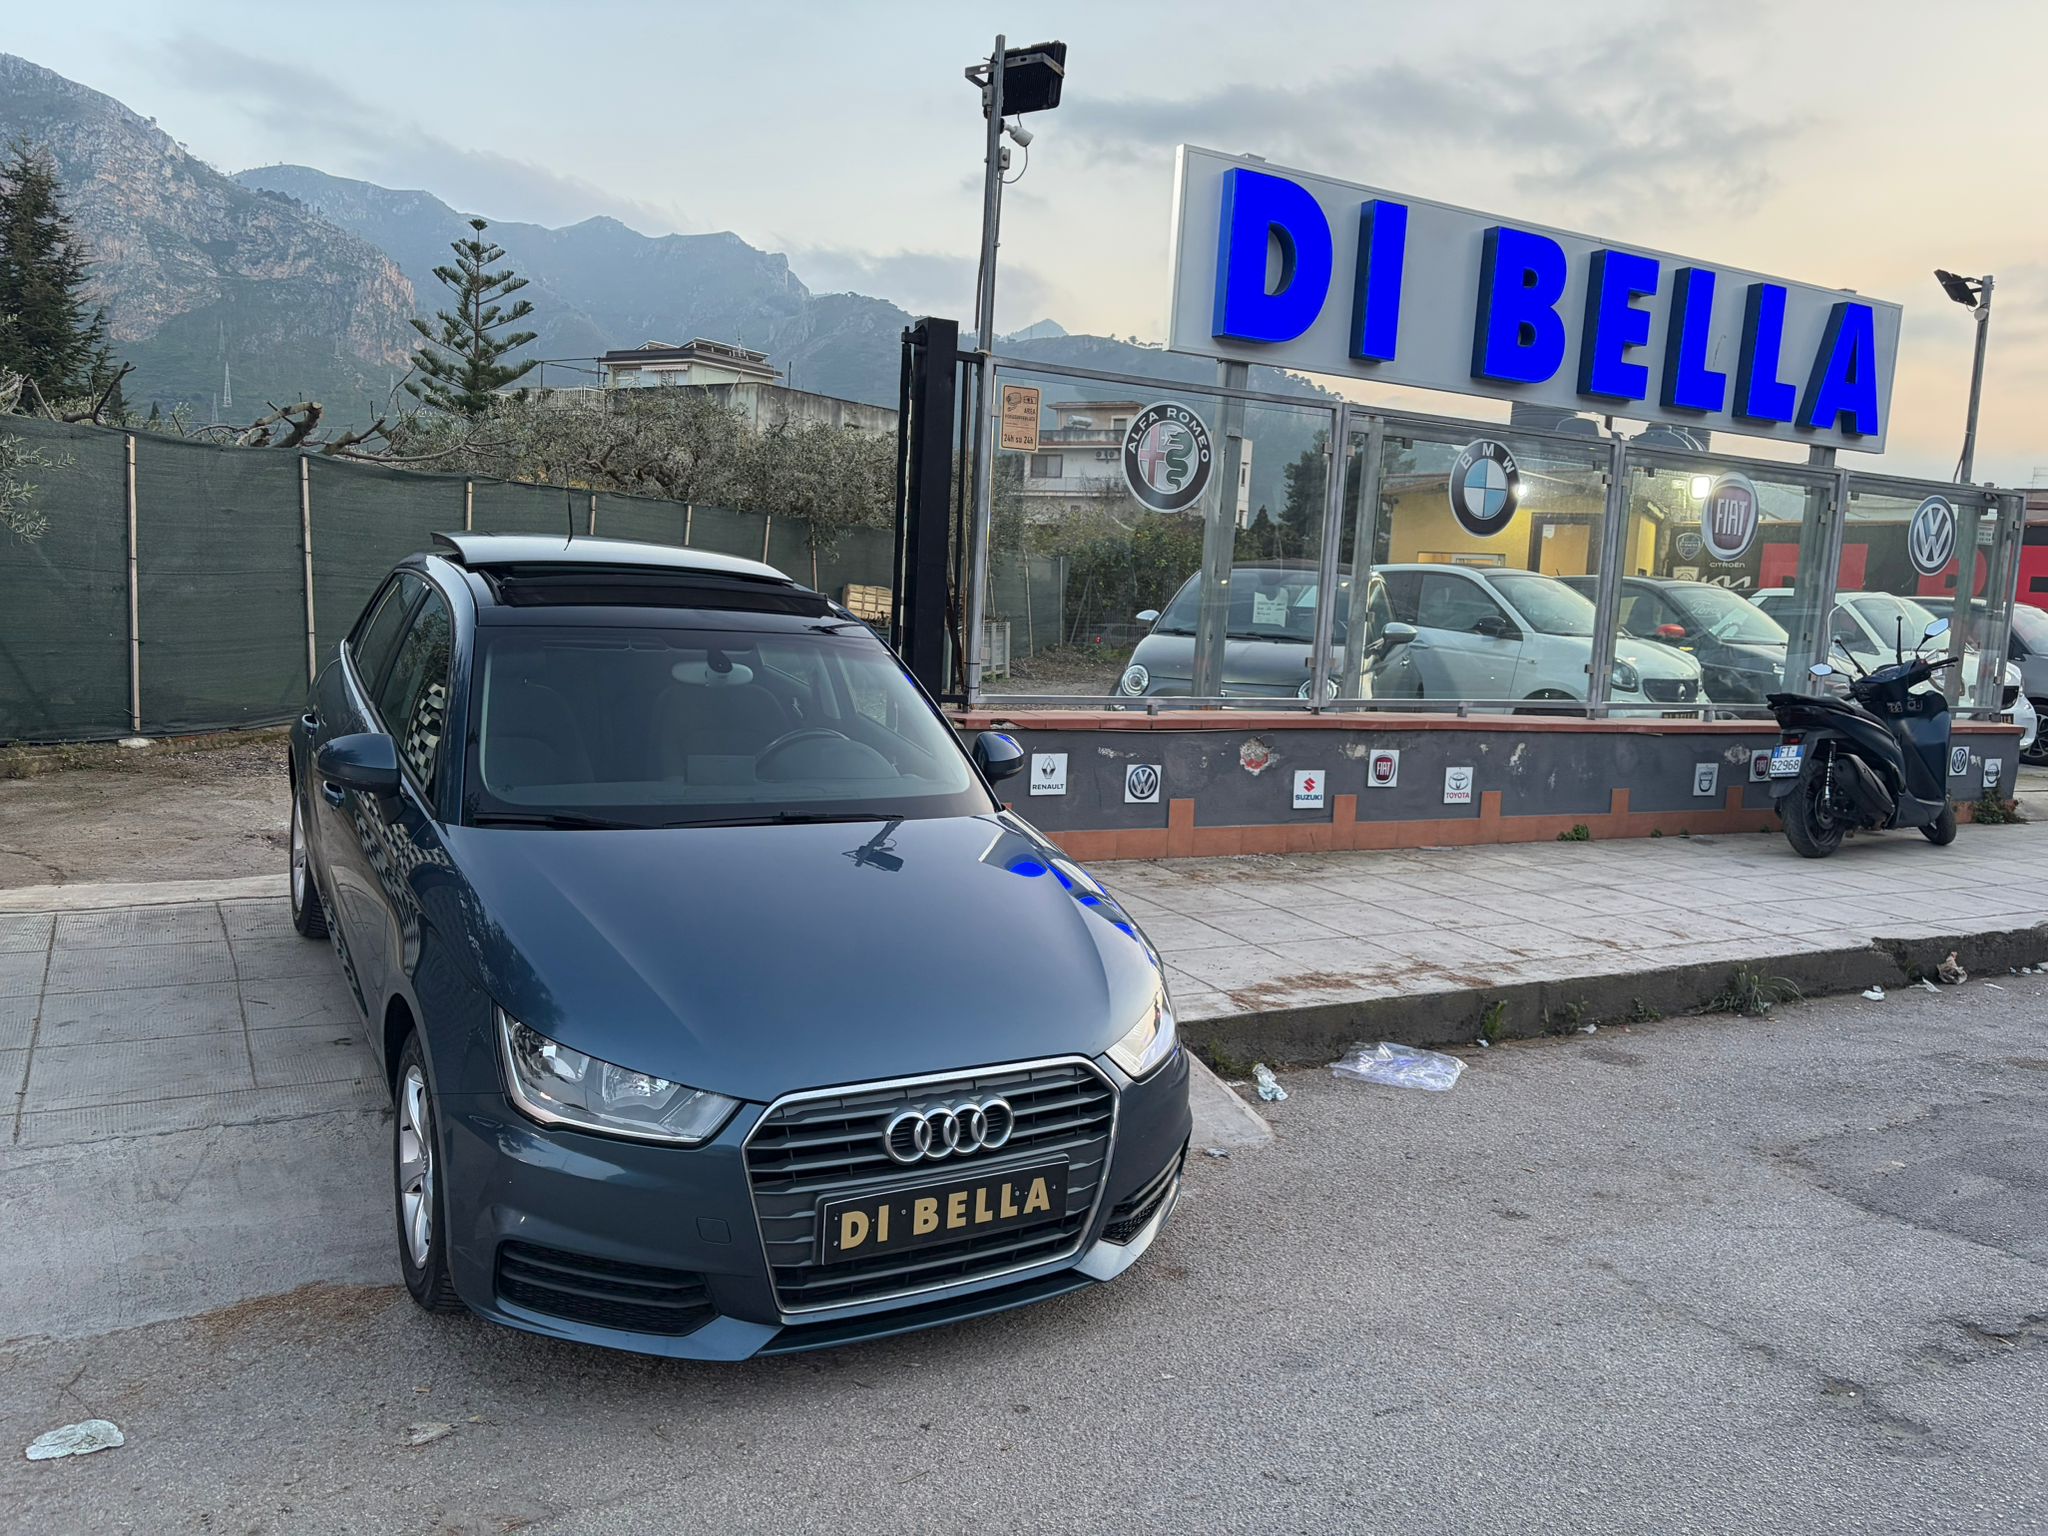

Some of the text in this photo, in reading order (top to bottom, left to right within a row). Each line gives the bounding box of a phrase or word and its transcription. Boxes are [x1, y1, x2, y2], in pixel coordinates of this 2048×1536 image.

[1213, 167, 1879, 437] DI BELLA
[1128, 407, 1210, 462] ALFA ROMEO
[1460, 442, 1515, 474] BMW
[1715, 498, 1748, 536] FIAT
[1376, 761, 1391, 776] FIAT
[1771, 759, 1800, 771] 62968
[1446, 791, 1470, 799] TOYOTA
[840, 1176, 1052, 1251] DI BELLA
